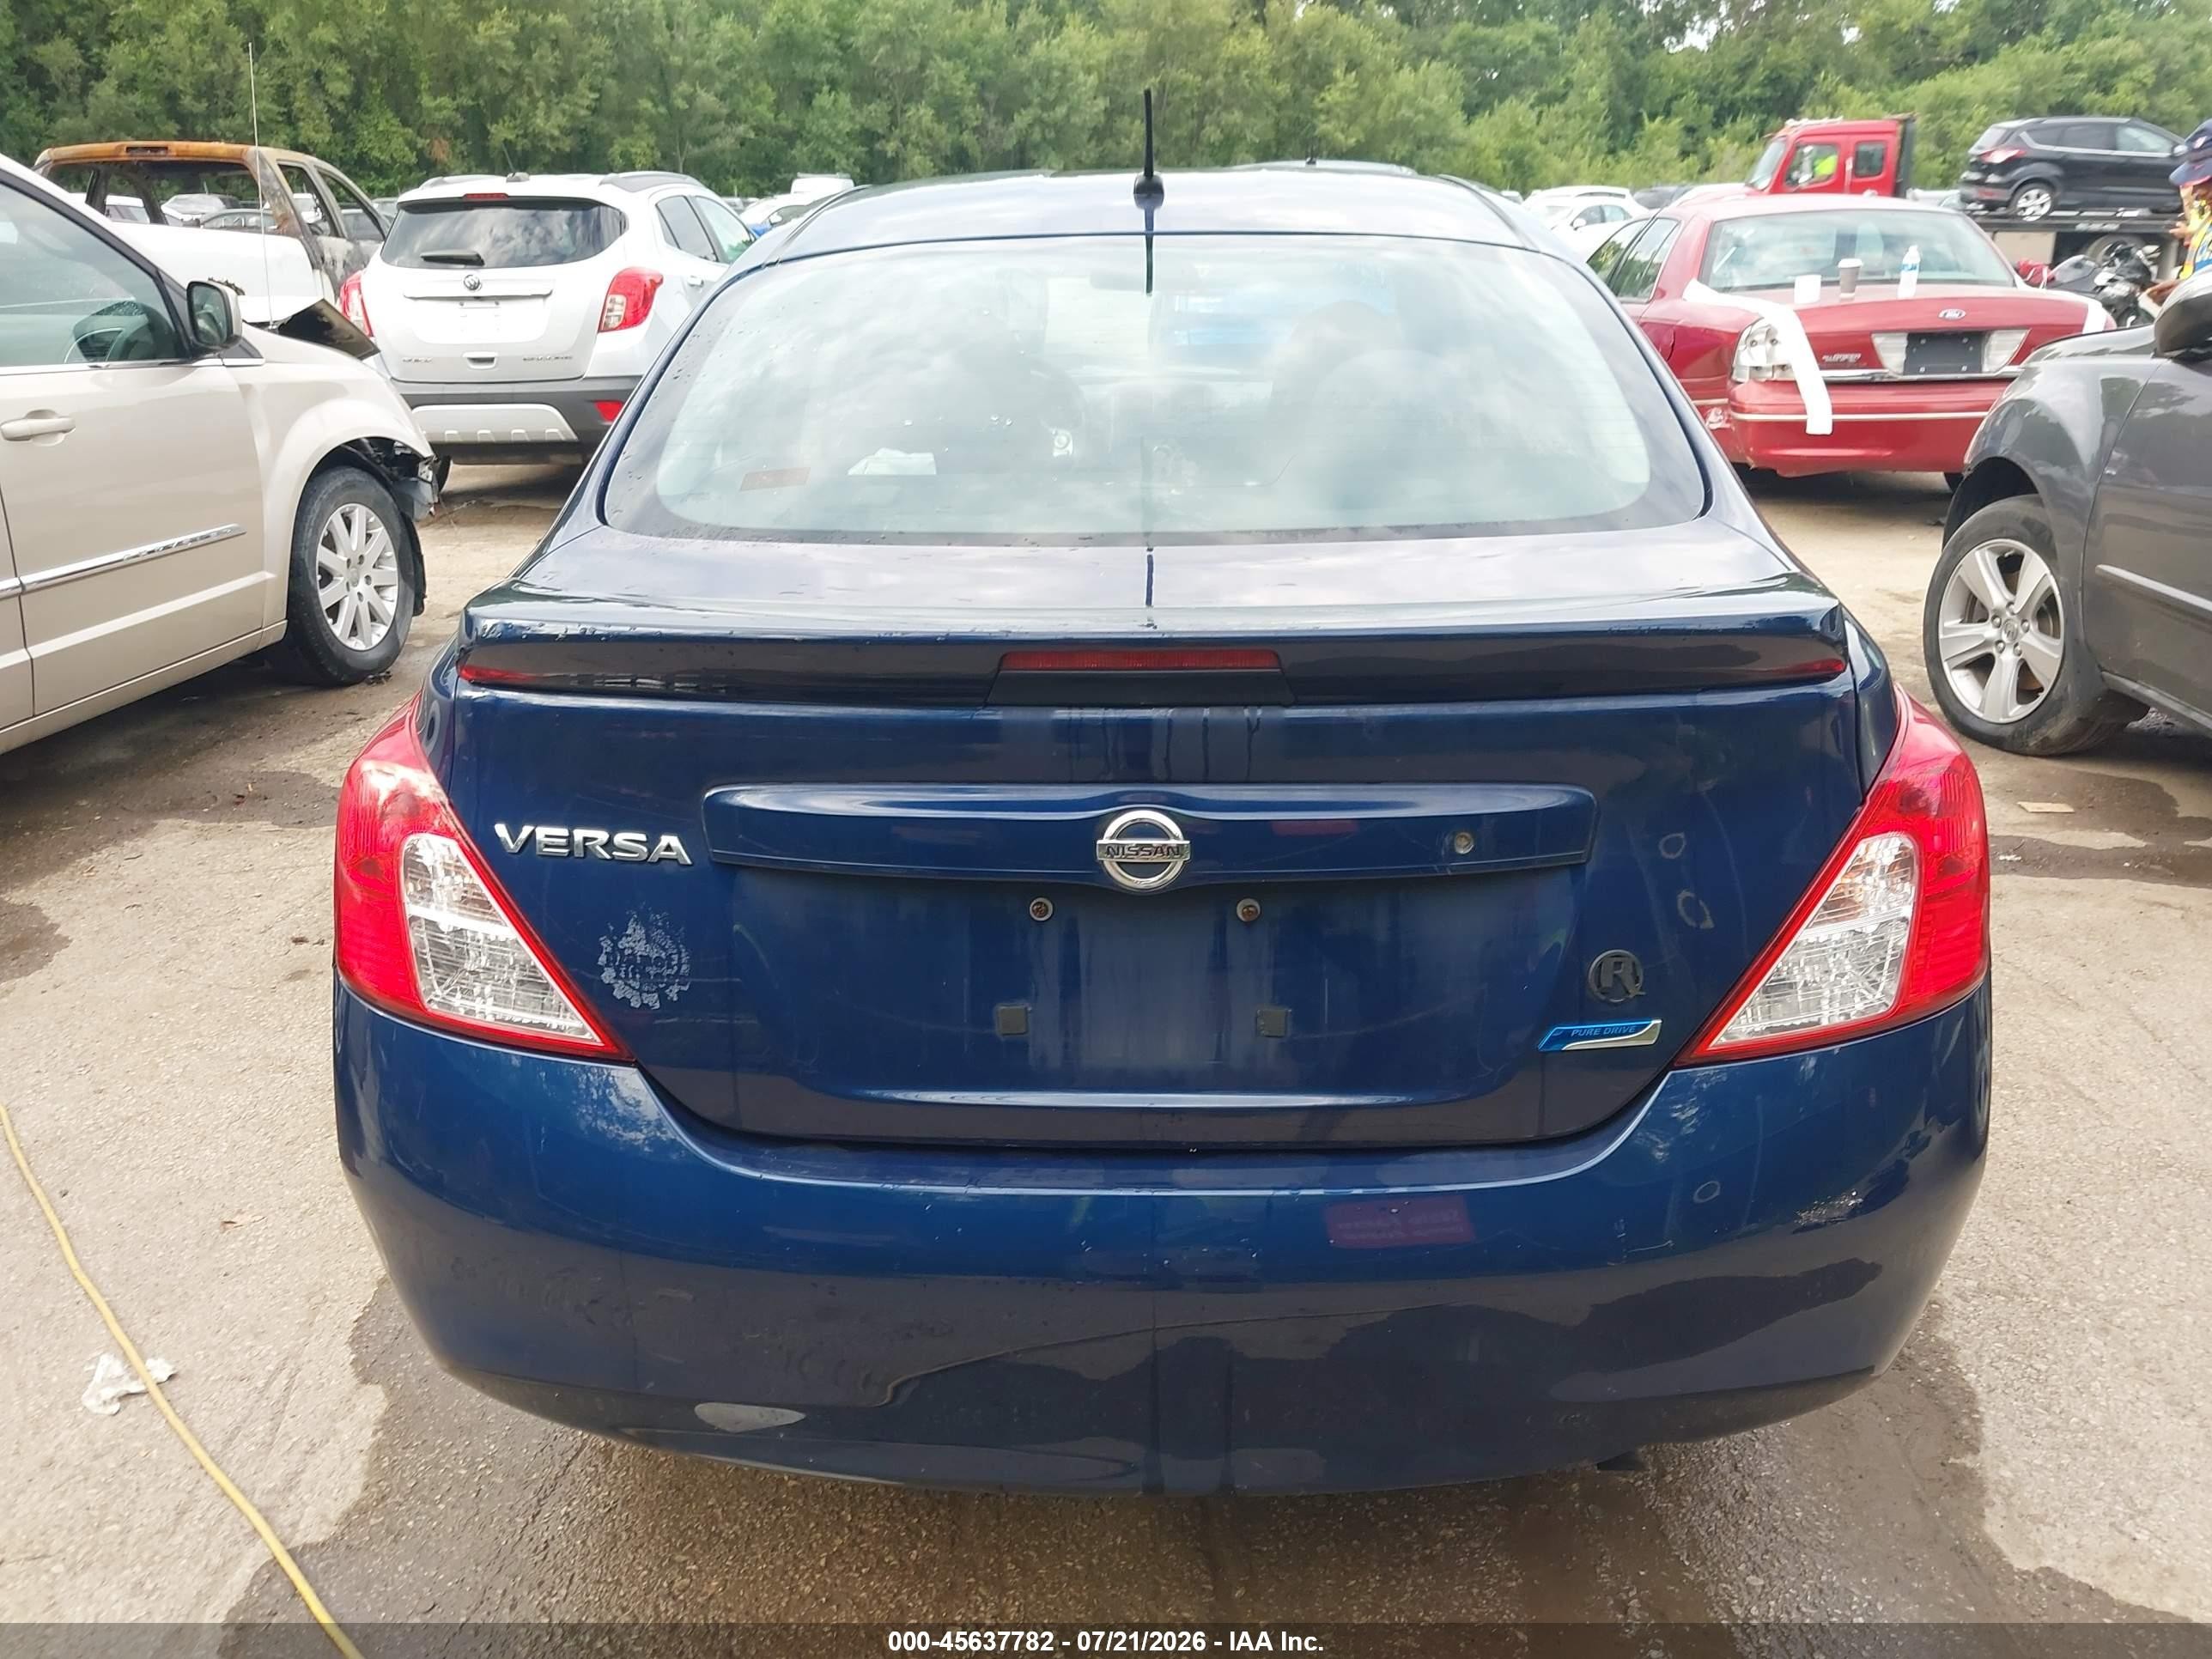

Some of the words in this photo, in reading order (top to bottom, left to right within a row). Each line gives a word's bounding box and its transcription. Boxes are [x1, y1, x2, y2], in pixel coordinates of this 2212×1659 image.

[494, 823, 693, 866] VERSA
[1106, 845, 1180, 858] NISSAN
[1571, 1027, 1601, 1037] PURE
[1602, 1025, 1637, 1036] DRIVE
